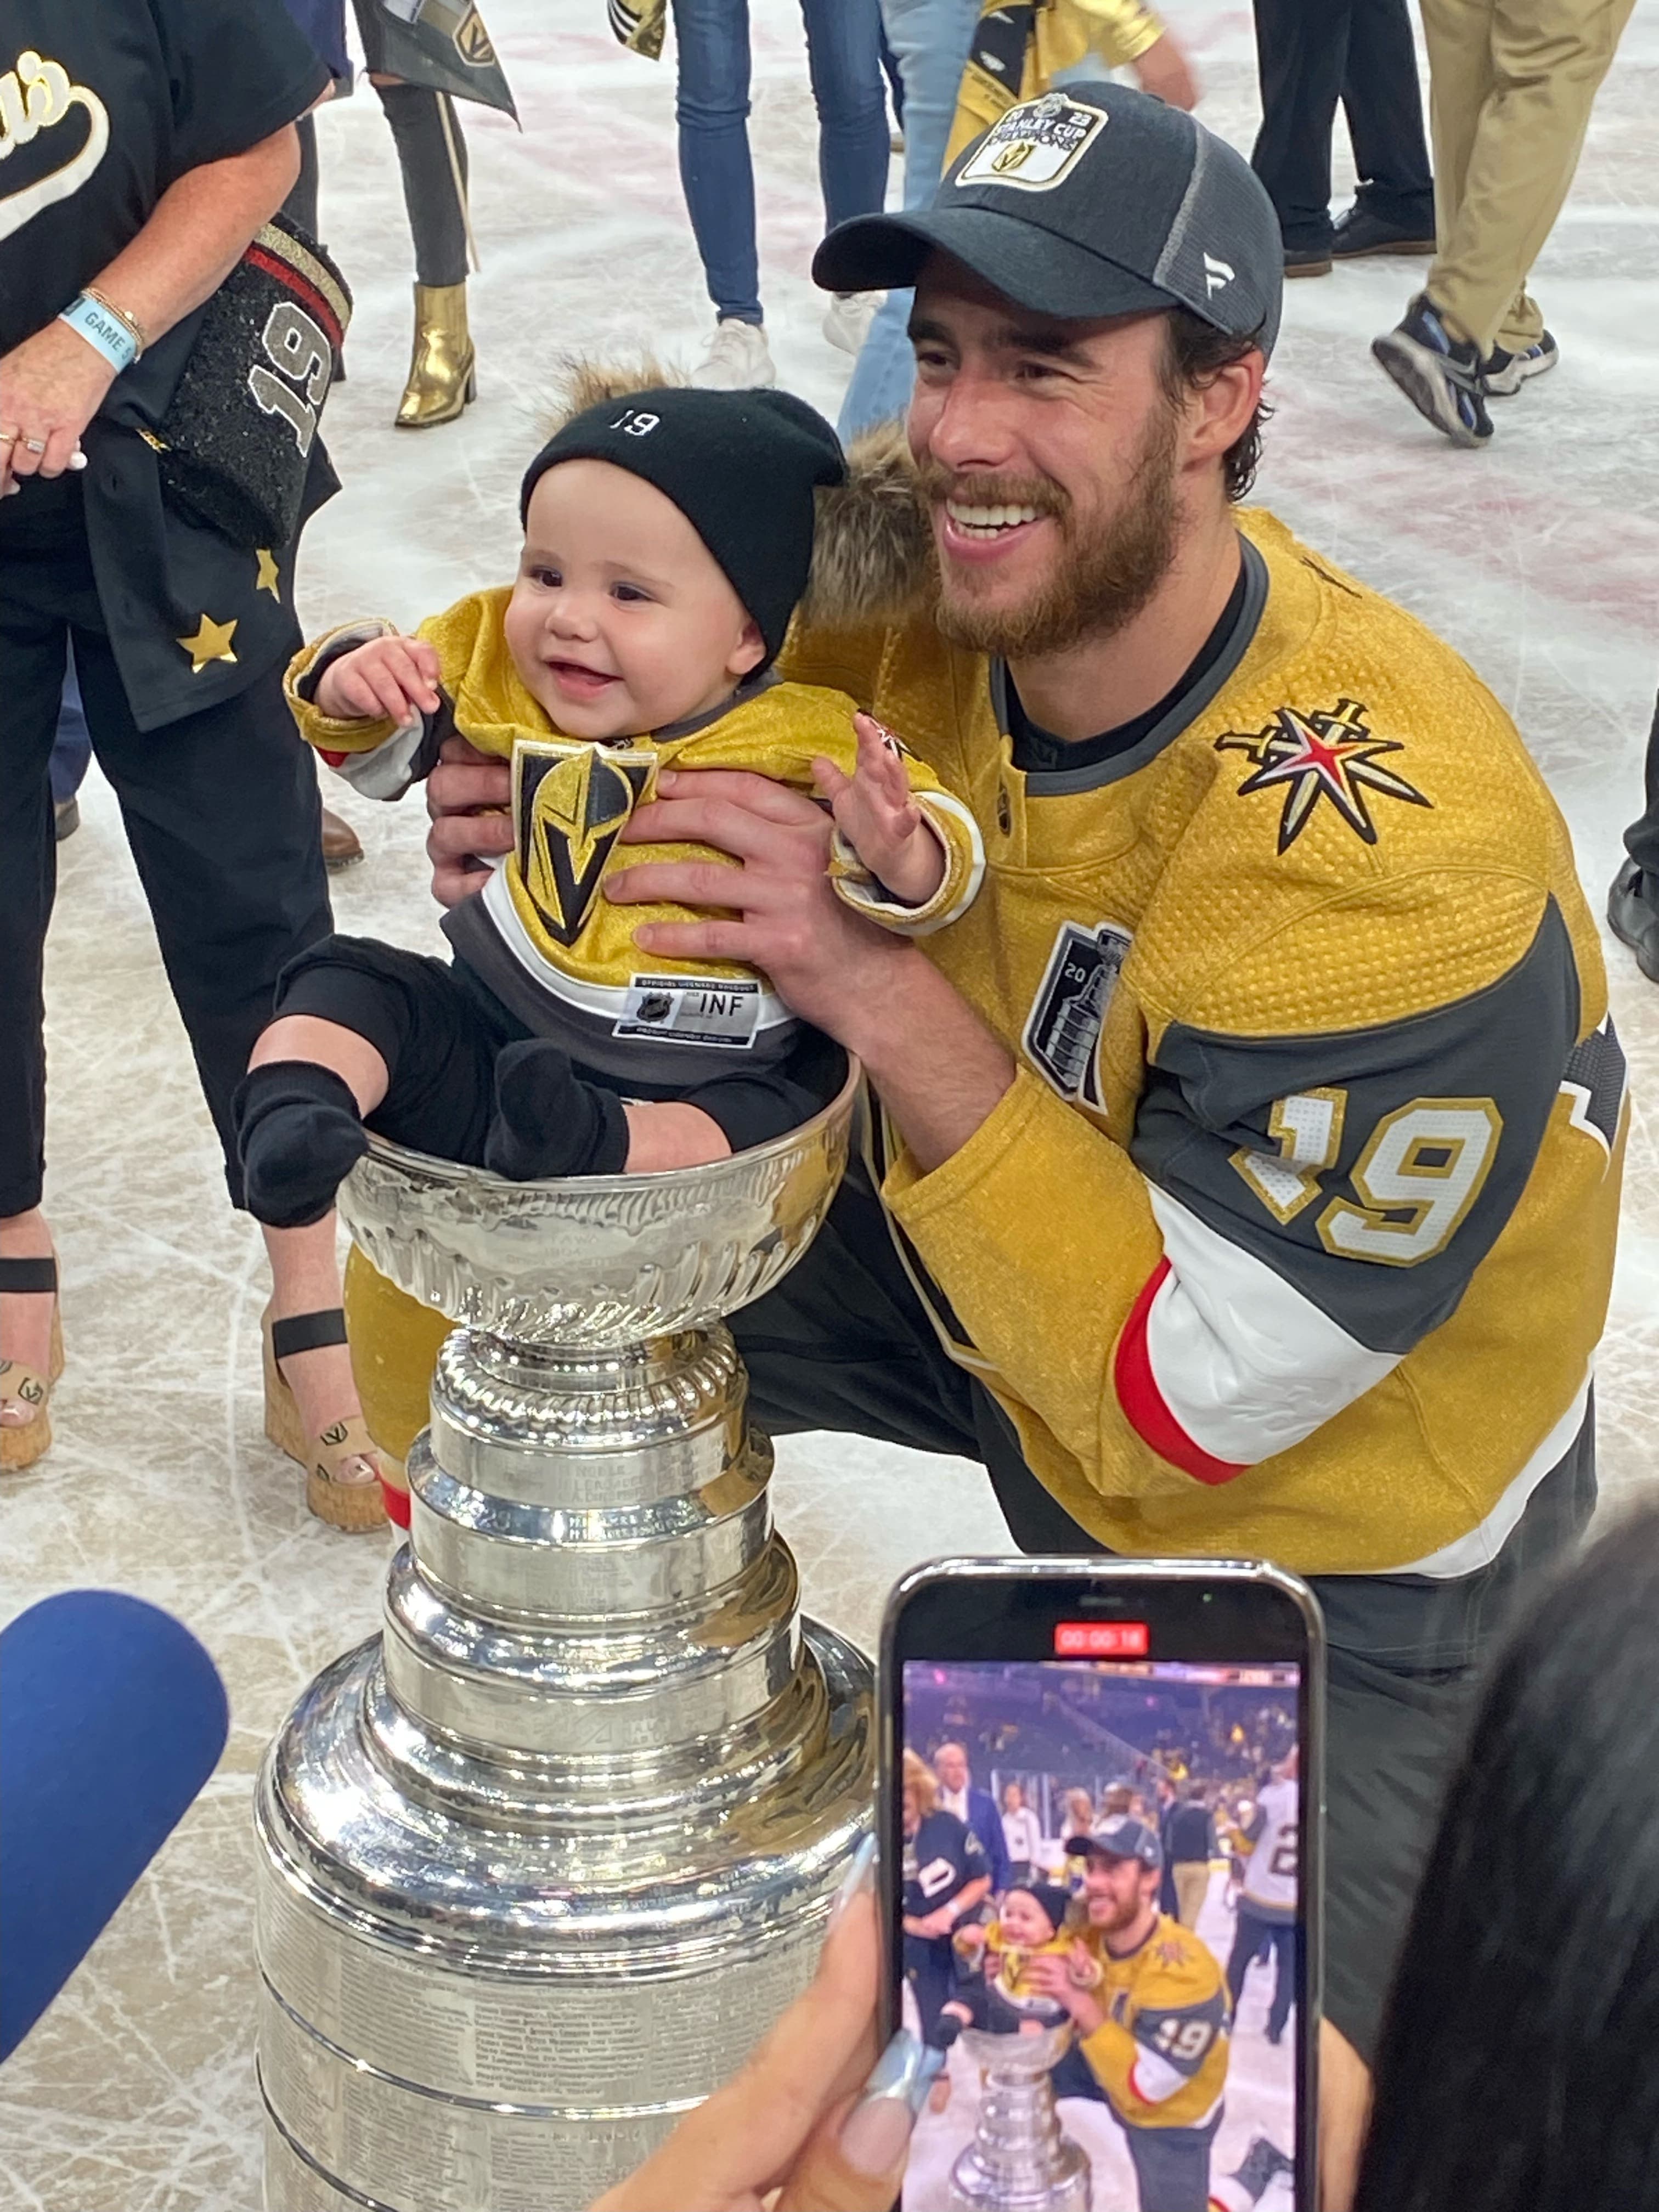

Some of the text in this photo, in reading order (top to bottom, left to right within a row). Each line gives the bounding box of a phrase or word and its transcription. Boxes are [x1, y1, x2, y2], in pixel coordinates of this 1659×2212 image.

[1053, 123, 1087, 139] CUP
[1068, 111, 1092, 127] 23
[84, 311, 132, 360] GAME 5
[248, 301, 332, 458] 19
[610, 409, 660, 437] 19
[1064, 961, 1086, 984] 20
[699, 992, 744, 1017] INF
[1227, 1086, 1504, 1268] 19
[1154, 2018, 1212, 2061] 19
